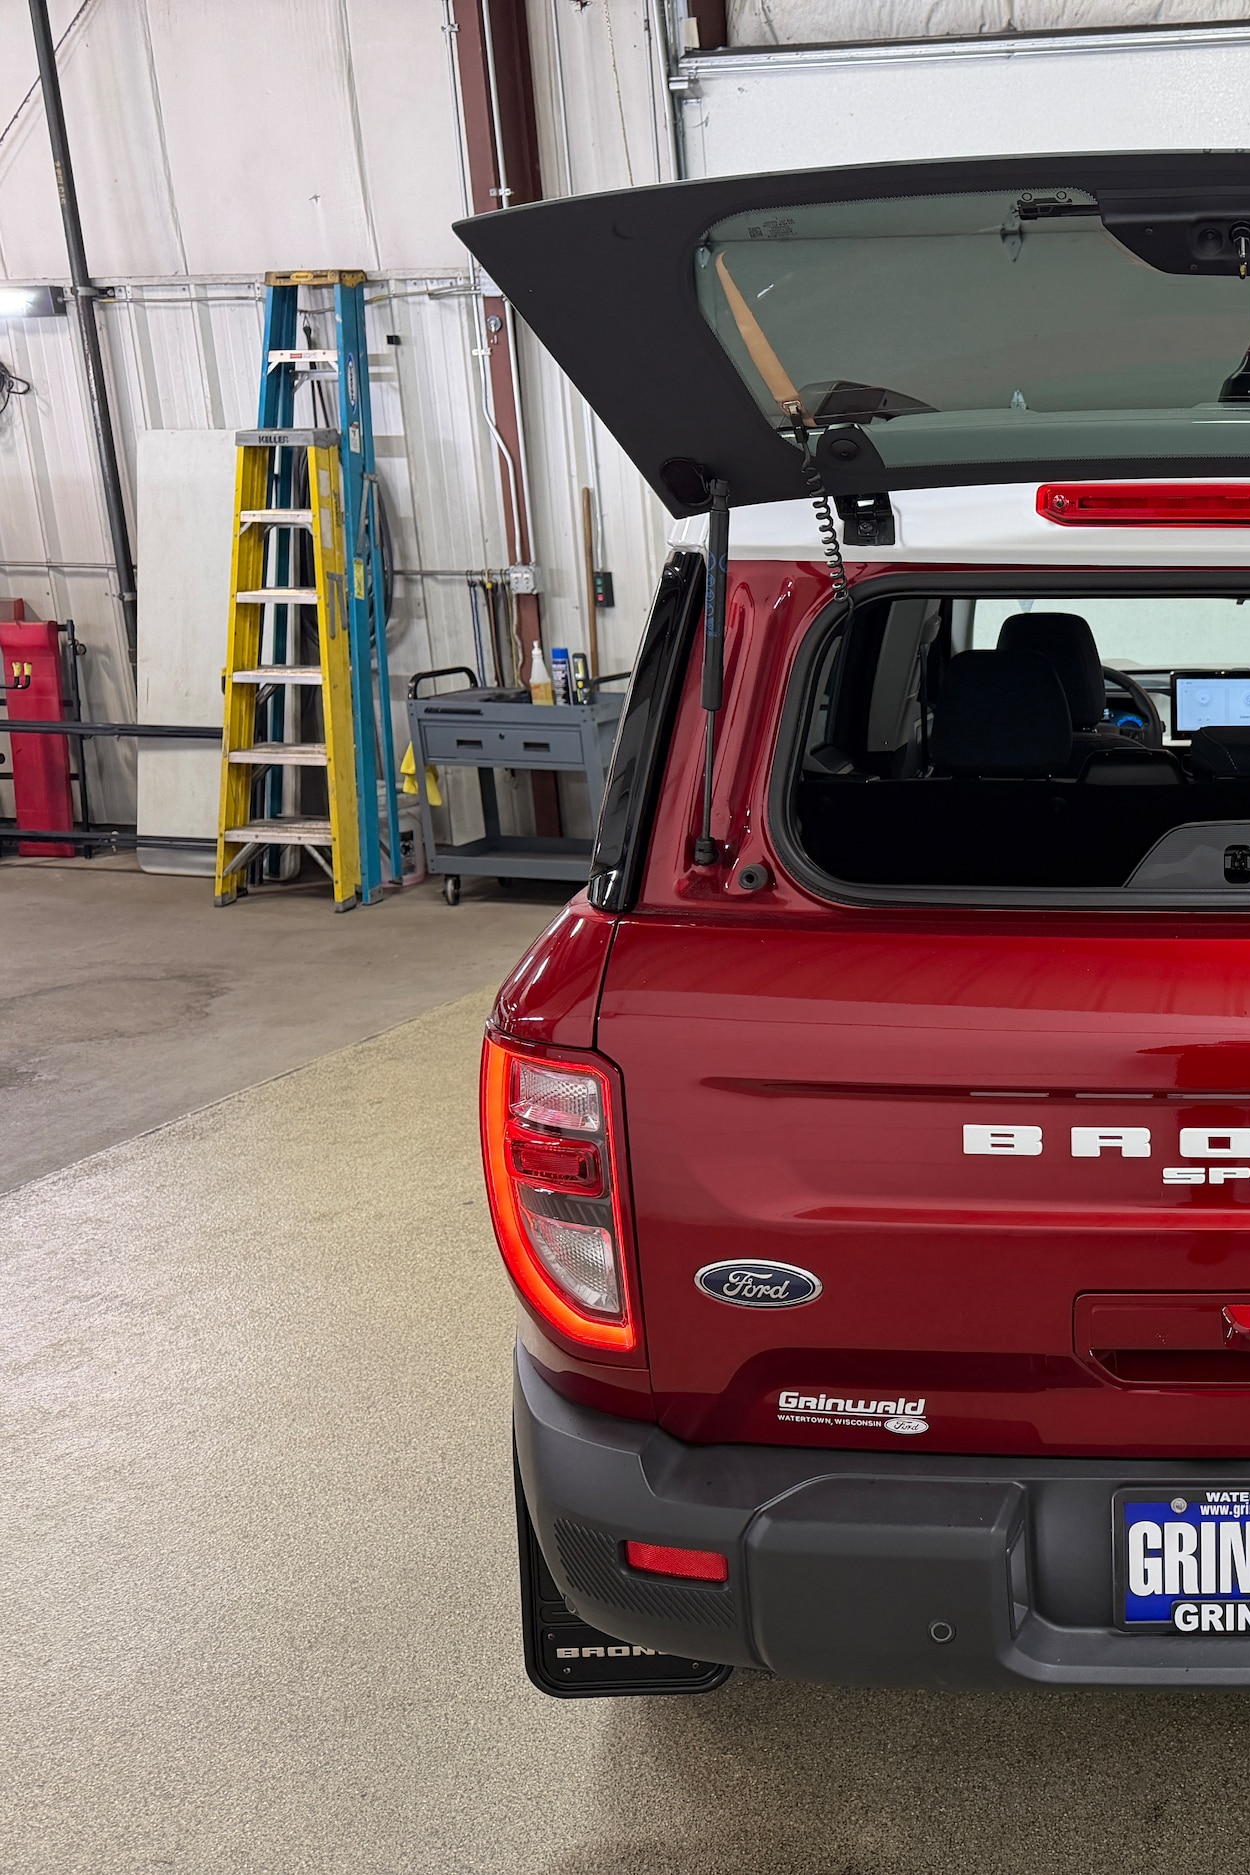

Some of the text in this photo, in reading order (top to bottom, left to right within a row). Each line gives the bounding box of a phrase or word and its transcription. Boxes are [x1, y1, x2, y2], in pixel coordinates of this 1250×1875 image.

[723, 1270, 790, 1300] Ford
[777, 1414, 882, 1427] WATERTOWN, WISCONSIN
[893, 1421, 920, 1431] Ford
[556, 1646, 671, 1658] BRON
